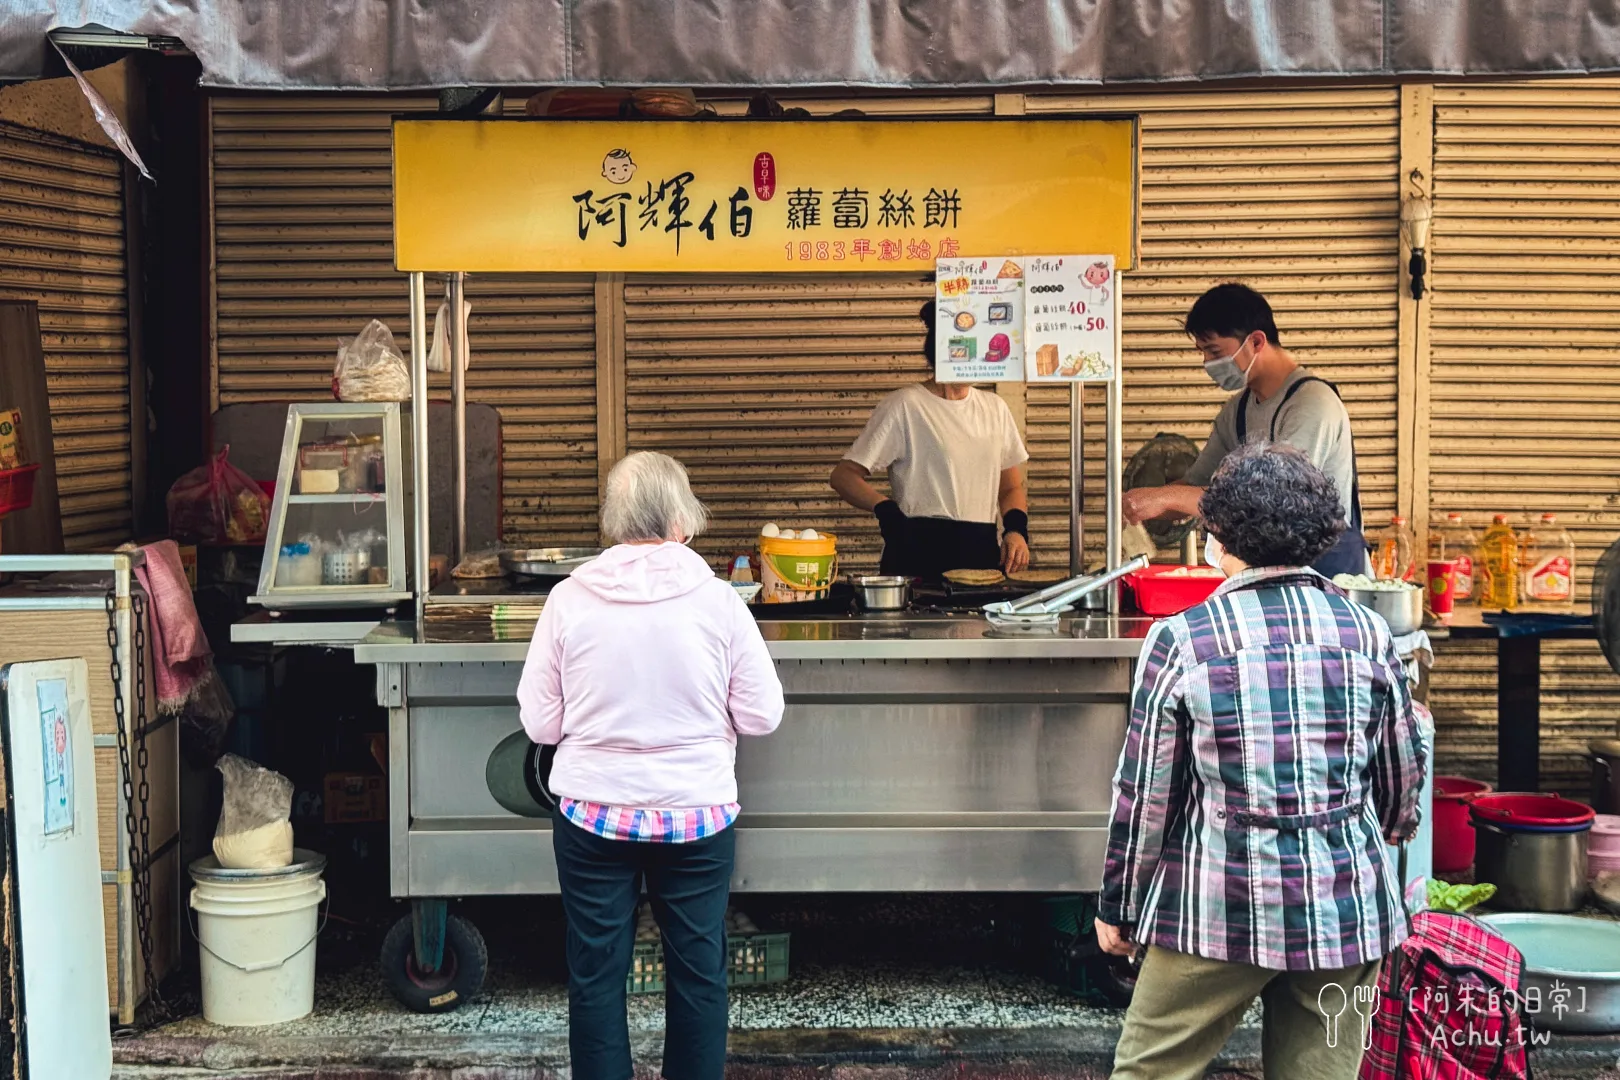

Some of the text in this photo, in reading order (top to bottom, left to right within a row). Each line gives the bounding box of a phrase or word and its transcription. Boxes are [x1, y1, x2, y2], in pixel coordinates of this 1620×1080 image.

[757, 154, 771, 200] 古早味
[573, 171, 753, 257] 阿輝伯
[786, 187, 962, 230] 蘿蔔絲餅
[785, 237, 961, 261] 1983年創始店
[1067, 301, 1086, 315] 40
[1086, 317, 1106, 332] 50
